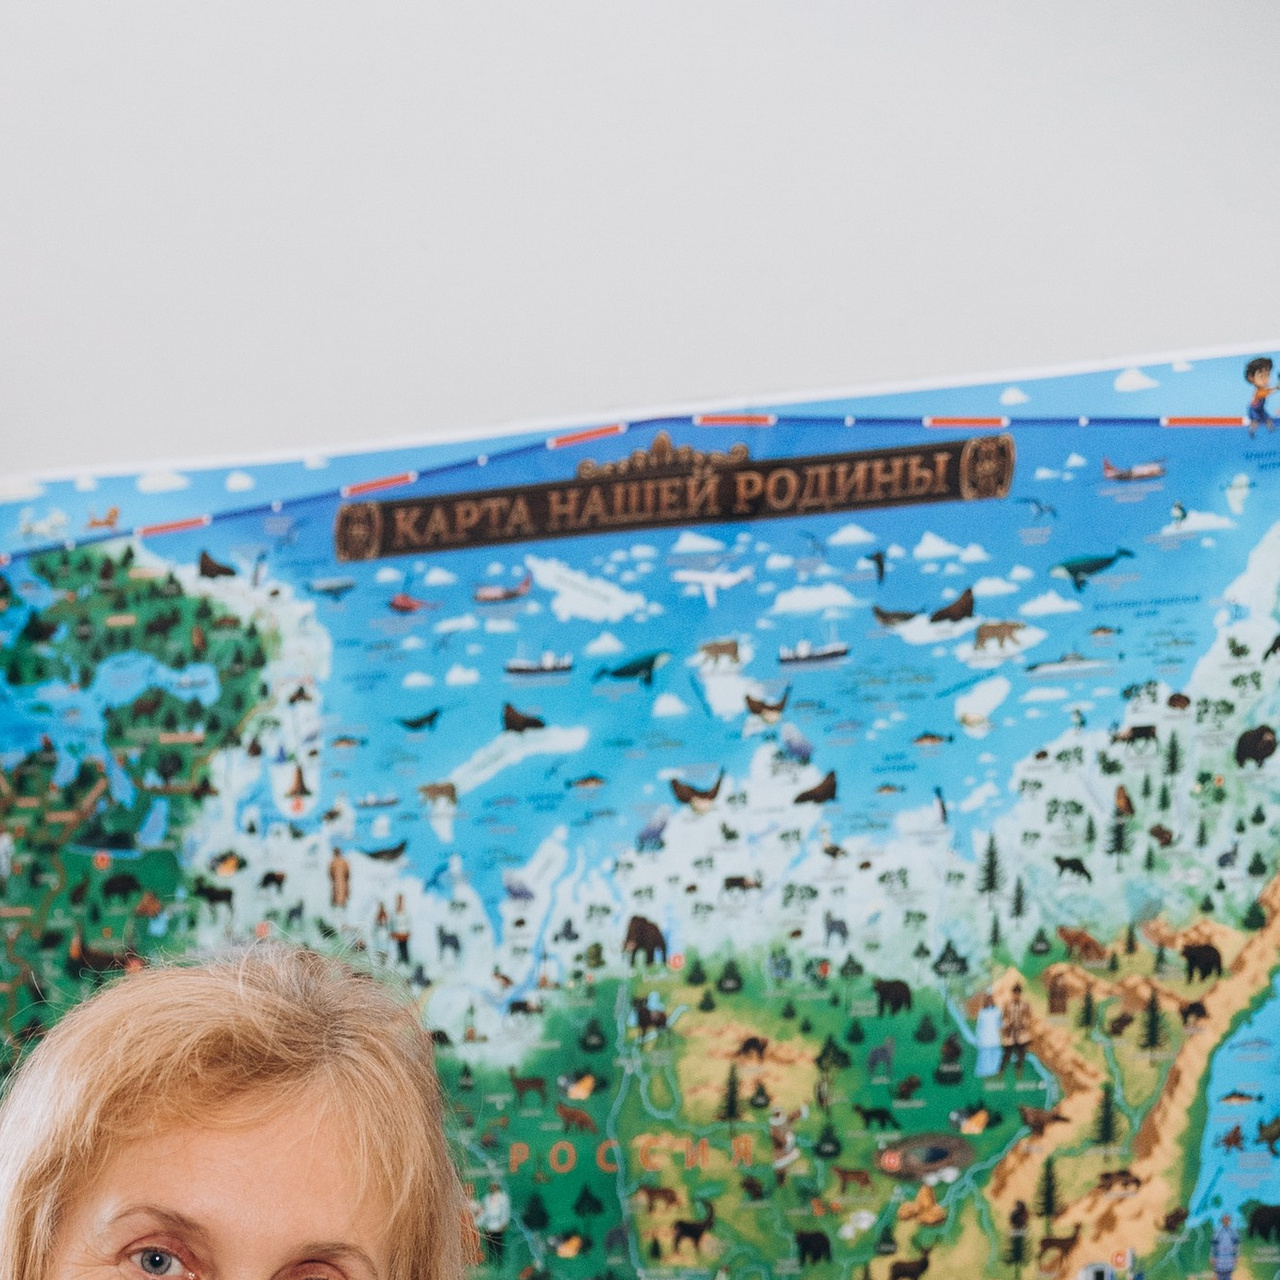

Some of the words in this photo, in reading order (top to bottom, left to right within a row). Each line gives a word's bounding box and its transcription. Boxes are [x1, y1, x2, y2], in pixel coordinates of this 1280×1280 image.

[393, 496, 534, 548] КАРТА
[547, 463, 720, 533] НАШЕЙ
[733, 452, 952, 514] РОДИНЫ
